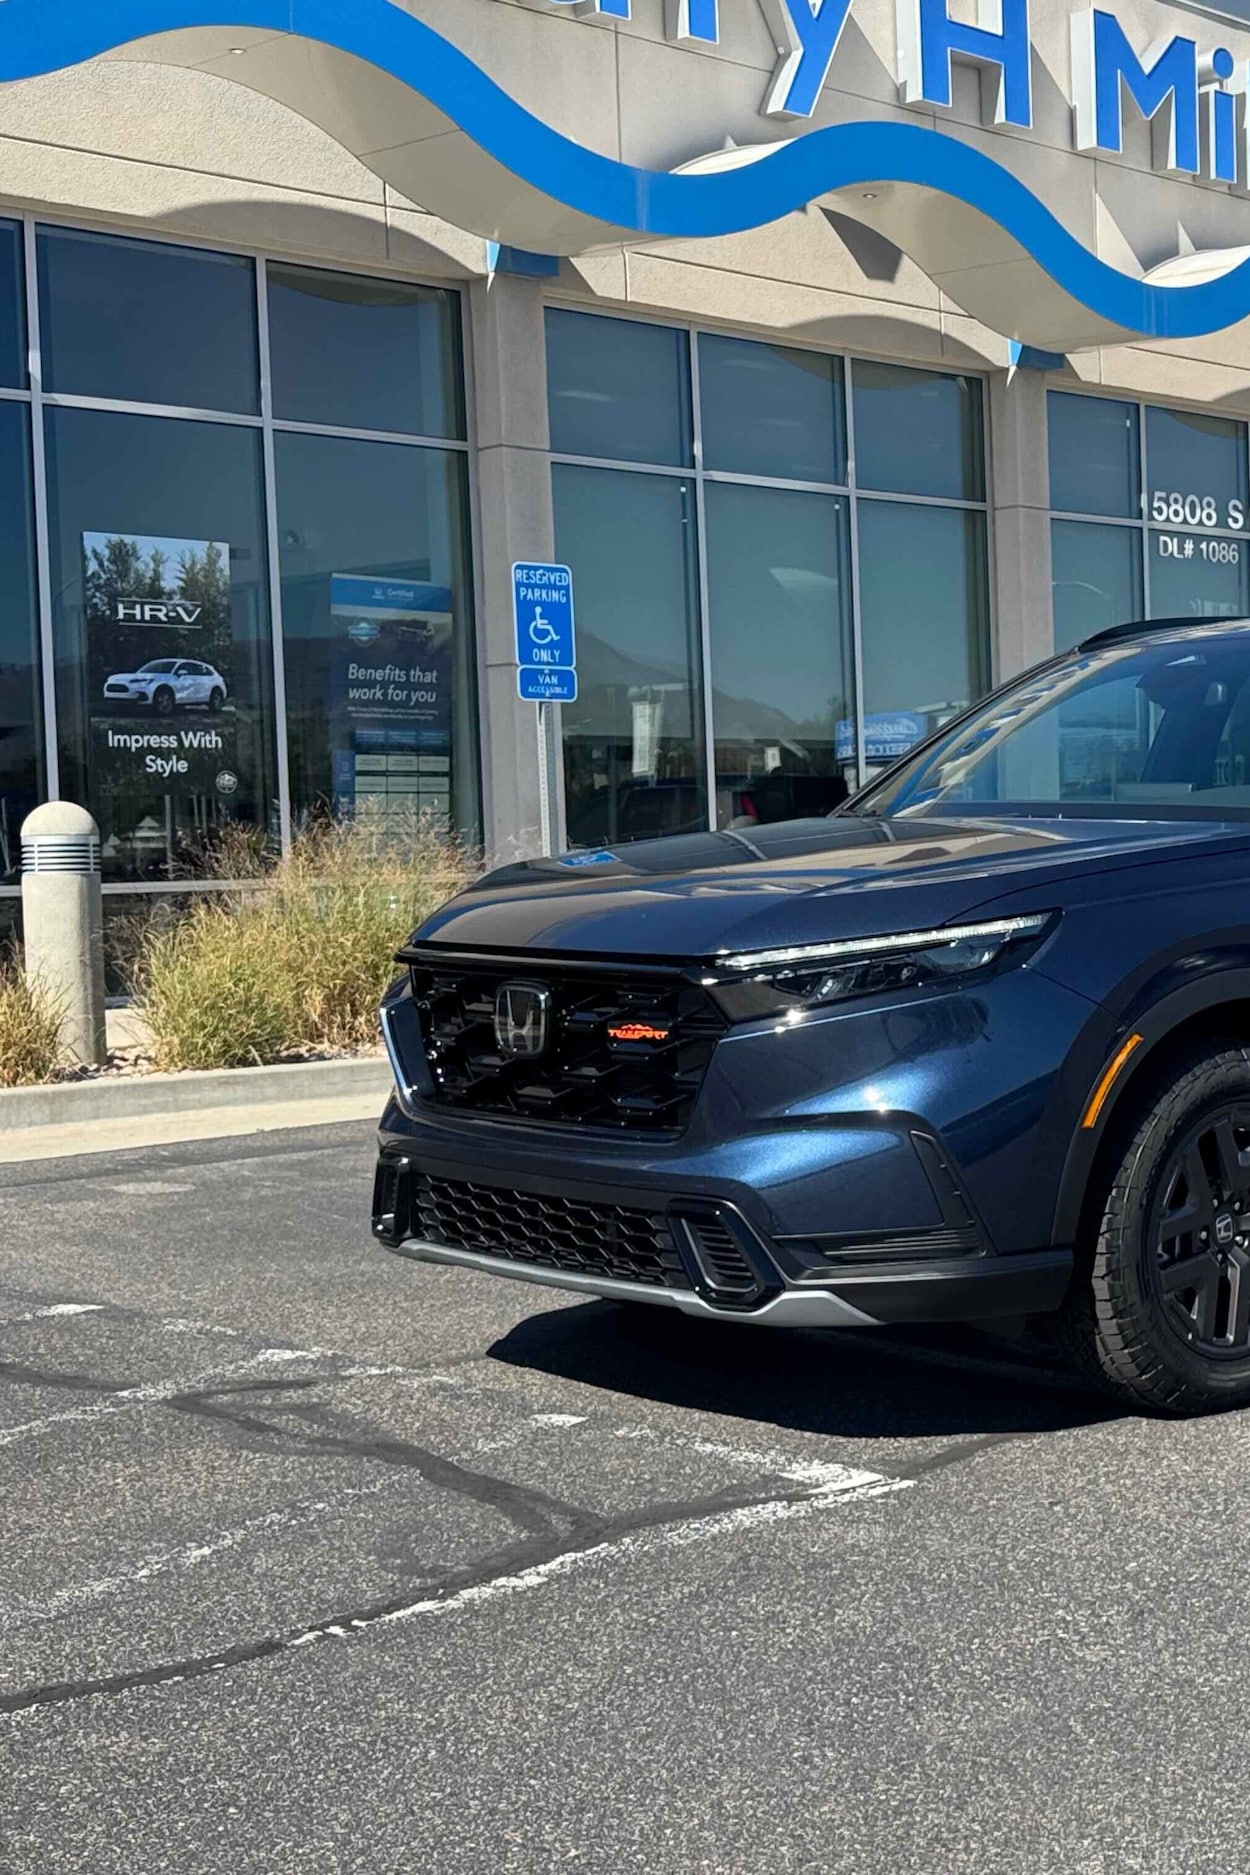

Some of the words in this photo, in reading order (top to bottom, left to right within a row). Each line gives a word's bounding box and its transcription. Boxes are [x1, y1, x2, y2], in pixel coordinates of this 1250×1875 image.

[1152, 491, 1217, 527] 5808
[1227, 499, 1244, 530] S
[1159, 535, 1194, 559] DL#
[1200, 540, 1240, 564] 1086
[515, 569, 569, 586] RESERVED
[519, 587, 567, 603] PARKING
[116, 603, 201, 622] HR-V
[532, 648, 561, 662] ONLY
[348, 663, 406, 682] Benefits
[409, 666, 439, 683] that
[537, 674, 558, 685] VAN
[348, 684, 384, 700] work
[387, 685, 409, 701] for
[409, 690, 437, 706] you
[108, 730, 178, 752] Impress
[180, 730, 223, 748] With
[145, 755, 188, 777] Style
